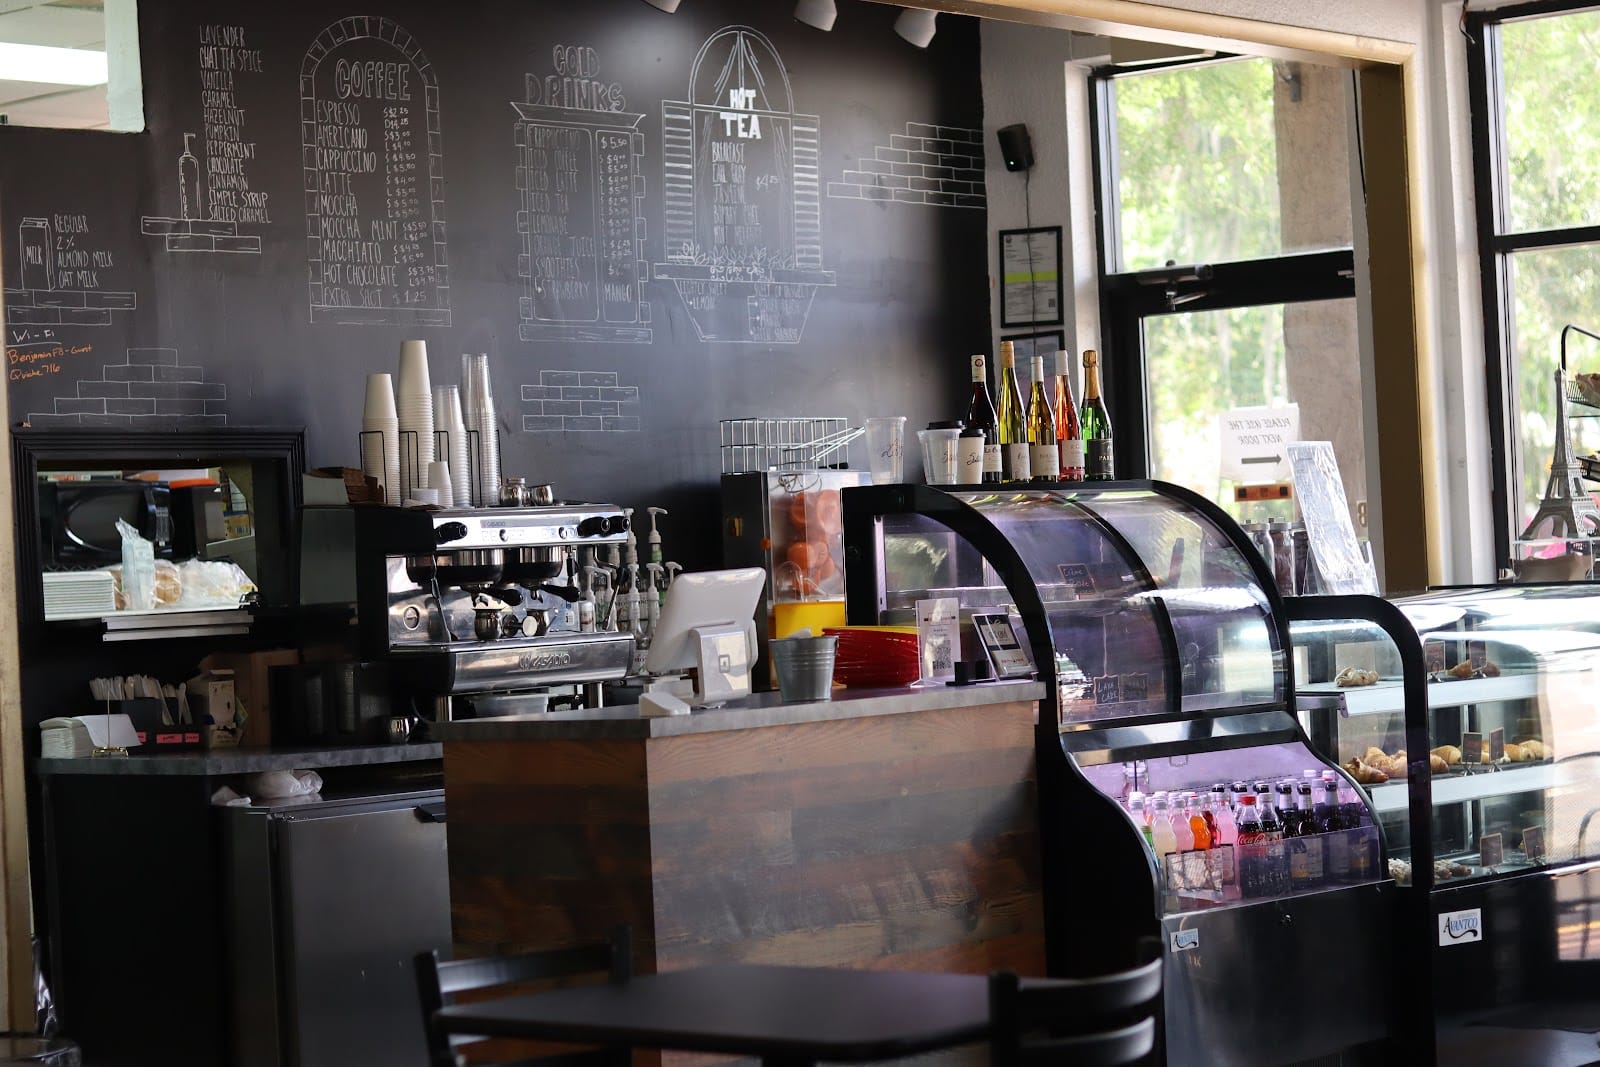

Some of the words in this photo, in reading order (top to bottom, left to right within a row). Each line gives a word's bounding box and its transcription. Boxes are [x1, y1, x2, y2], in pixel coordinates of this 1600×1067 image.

[199, 24, 246, 47] LAVENDER
[199, 46, 219, 70] CHAI
[220, 47, 237, 71] TEA
[238, 48, 264, 73] SPICE
[200, 70, 234, 91] VANILLA
[335, 58, 412, 101] COFFEE
[201, 90, 238, 109] CARAMEL
[525, 72, 626, 112] DRINKS
[729, 88, 757, 110] HOT
[203, 108, 246, 127] HAZELNUT
[316, 99, 361, 126] ESPRESSO
[205, 125, 240, 142] PUMPKIN
[720, 112, 762, 140] TEA
[317, 124, 369, 150] AMERICANO
[206, 140, 256, 160] PEPPERMINT
[317, 147, 378, 173] CAPPUCCINO
[206, 157, 245, 176] CHOCOLATE
[208, 174, 249, 191] CINNAMON
[319, 171, 355, 197] LATTE
[209, 189, 239, 208] SIMPLE
[241, 191, 269, 209] SYRUP
[54, 214, 89, 233] REGULAR
[209, 205, 236, 222] SALTED
[238, 207, 272, 224] CARAMEL
[371, 219, 400, 241] MINT
[26, 245, 44, 266] MILK
[57, 251, 90, 269] ALMOND
[92, 251, 114, 268] MILK
[323, 239, 382, 265] MACCHIATO
[58, 270, 77, 289] OAT
[78, 271, 100, 289] MILK
[323, 262, 342, 285] HOT
[346, 264, 401, 288] CHOCOLATE
[603, 283, 633, 304] MANGO
